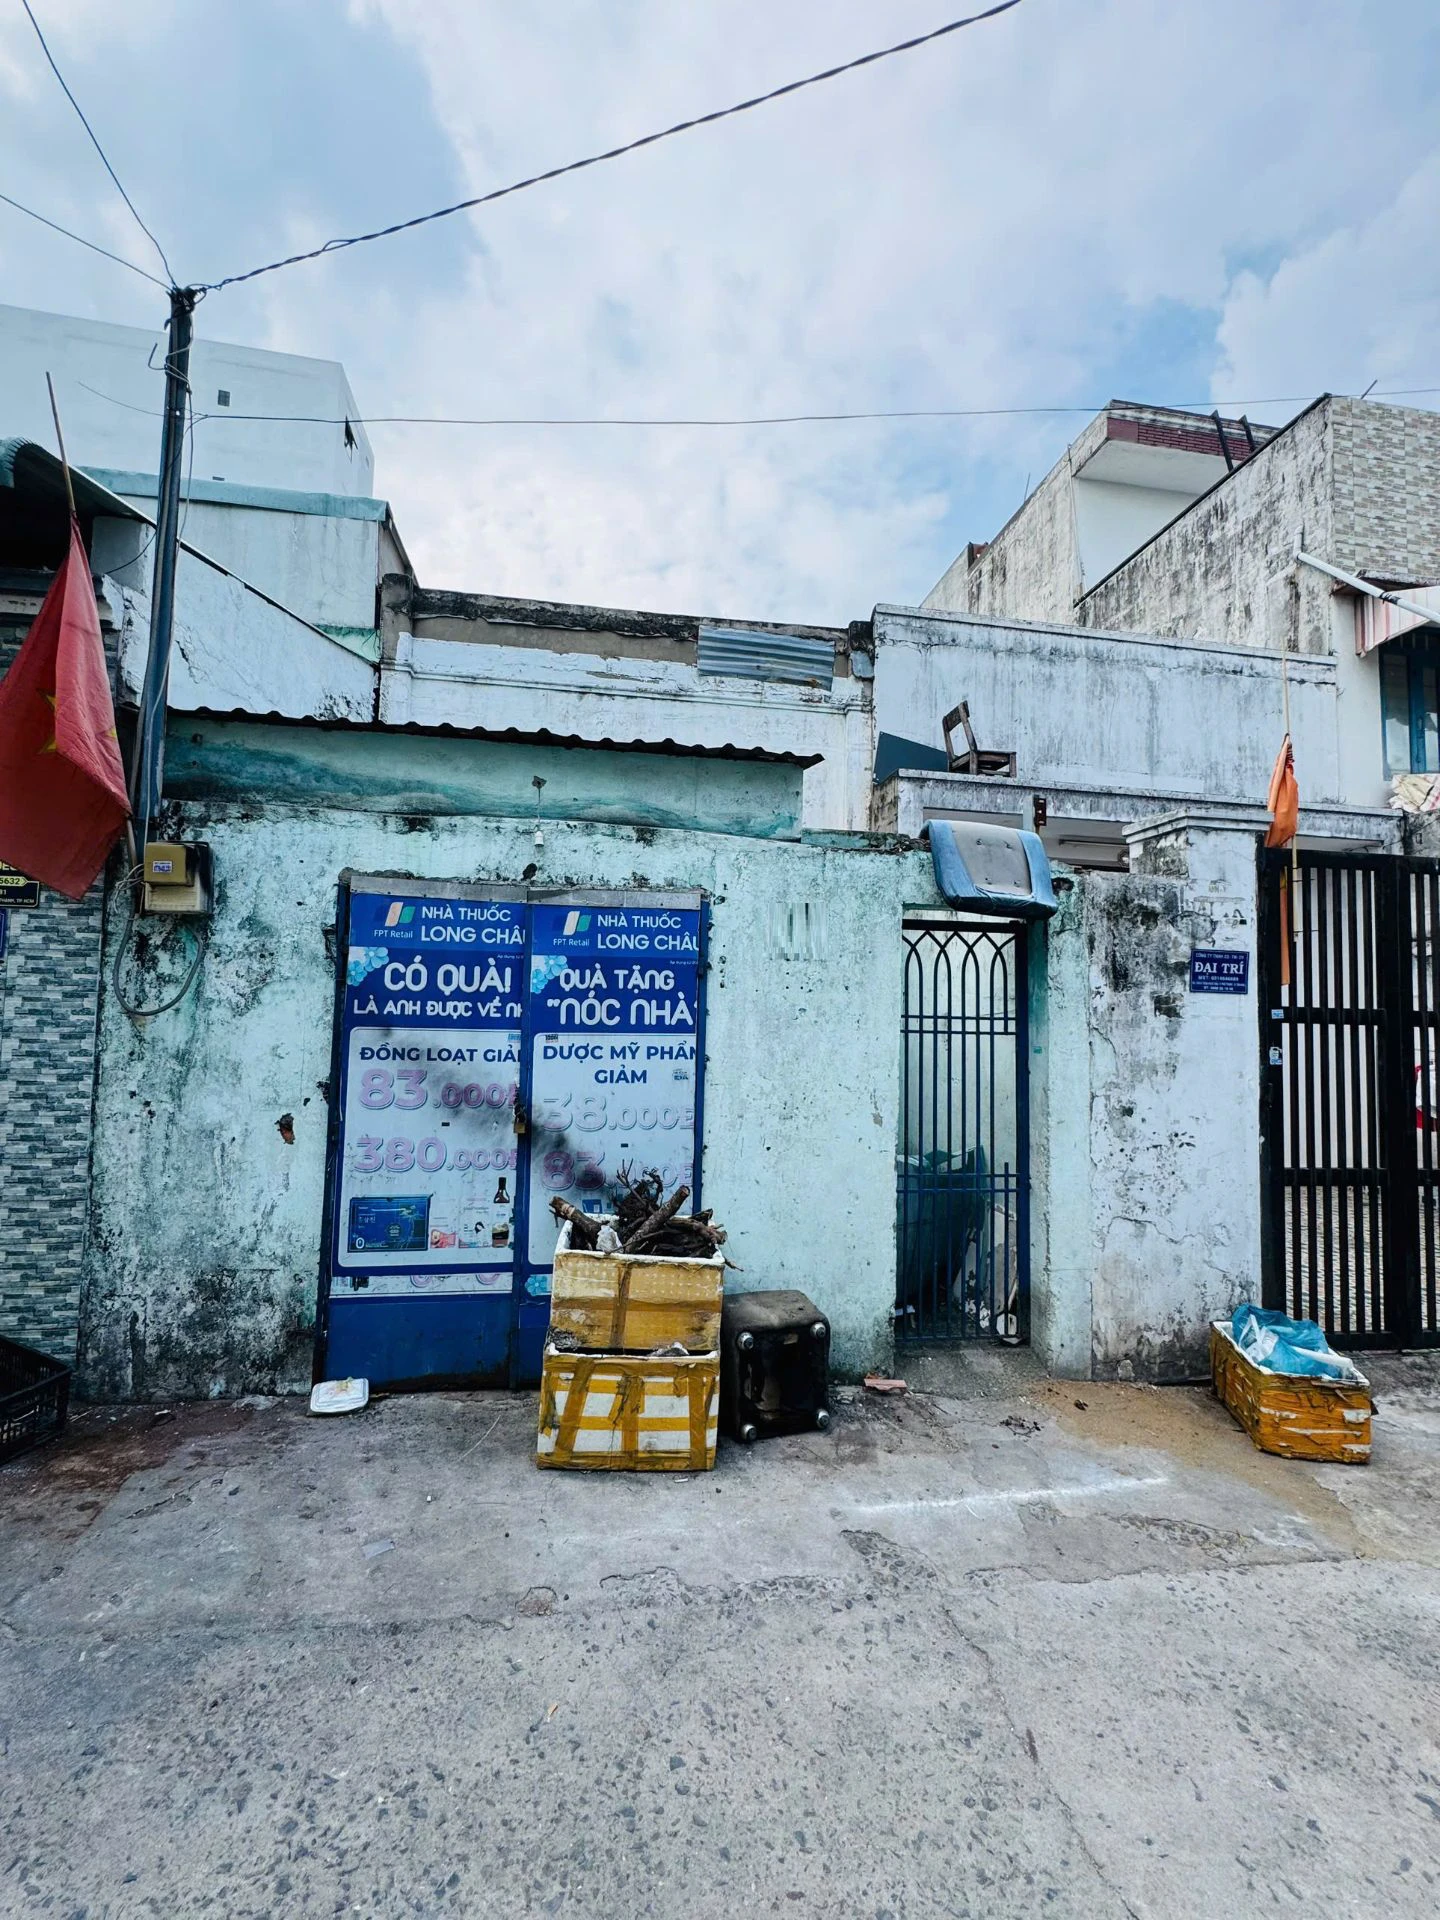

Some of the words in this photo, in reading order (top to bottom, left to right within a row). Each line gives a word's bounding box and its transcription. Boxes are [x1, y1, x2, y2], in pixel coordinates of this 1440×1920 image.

[422, 904, 454, 920] NHÀ
[458, 904, 511, 922] THUỐC
[597, 912, 628, 928] NHÀ
[632, 912, 682, 929] THUỐC
[374, 930, 388, 938] FPT
[390, 930, 413, 939] Retail
[421, 925, 477, 943] LONG
[553, 938, 566, 946] FPT
[569, 938, 590, 947] Retail
[597, 933, 649, 950] LONG
[384, 955, 427, 992] CÓ
[437, 957, 511, 996] QUÀ!
[1195, 961, 1217, 975] ĐẠI
[1221, 961, 1244, 974] TRÍ
[559, 962, 607, 992] QUÀ
[613, 964, 675, 994] TẶNG
[353, 995, 378, 1015] LÀ
[384, 999, 421, 1015] ANH
[426, 1000, 473, 1019] ĐƯỢC
[360, 1042, 421, 1062] ĐỒNG
[426, 1047, 478, 1065] LOẠT
[483, 1044, 521, 1062] GIẢ
[543, 1043, 604, 1063] DƯỢC
[610, 1042, 640, 1060] MỸ
[594, 1064, 647, 1084] GIẢM
